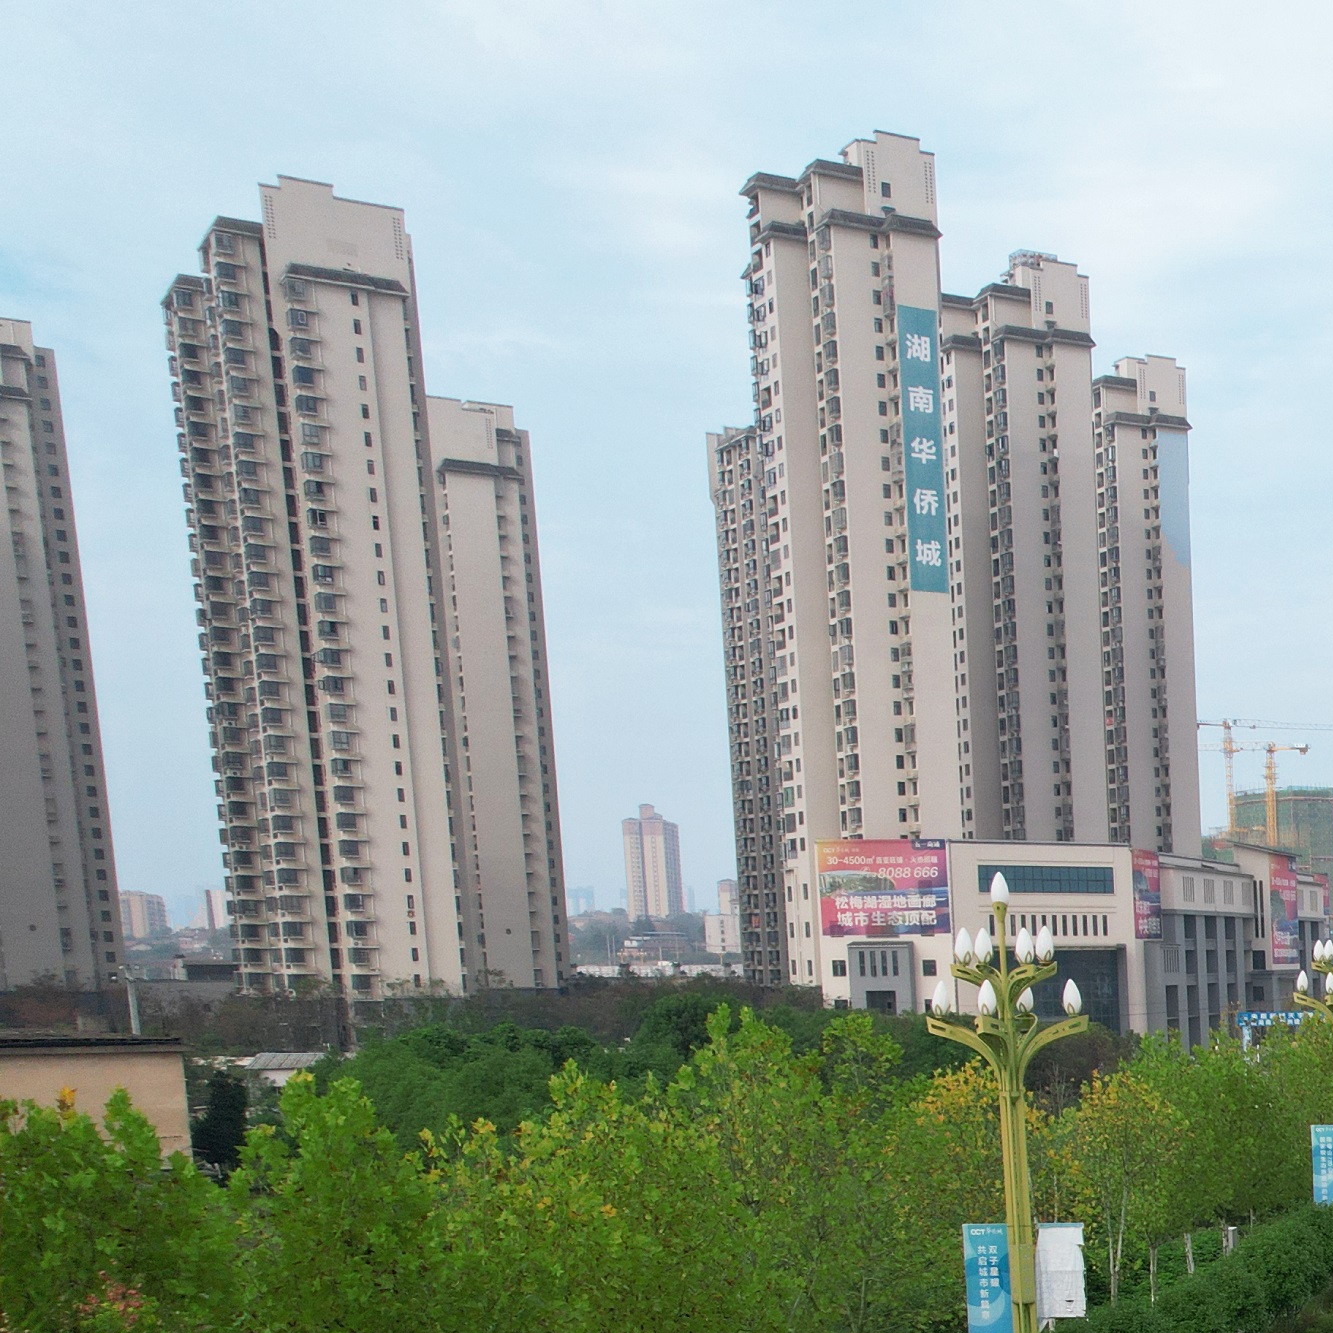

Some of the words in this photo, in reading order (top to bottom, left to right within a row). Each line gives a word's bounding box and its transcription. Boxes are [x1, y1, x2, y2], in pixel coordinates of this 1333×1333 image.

[905, 333, 941, 566] 湖南华侨城
[914, 866, 938, 878] 666
[835, 895, 936, 909] 松梅湖湿地画廊
[837, 910, 937, 926] 城市生态顶配
